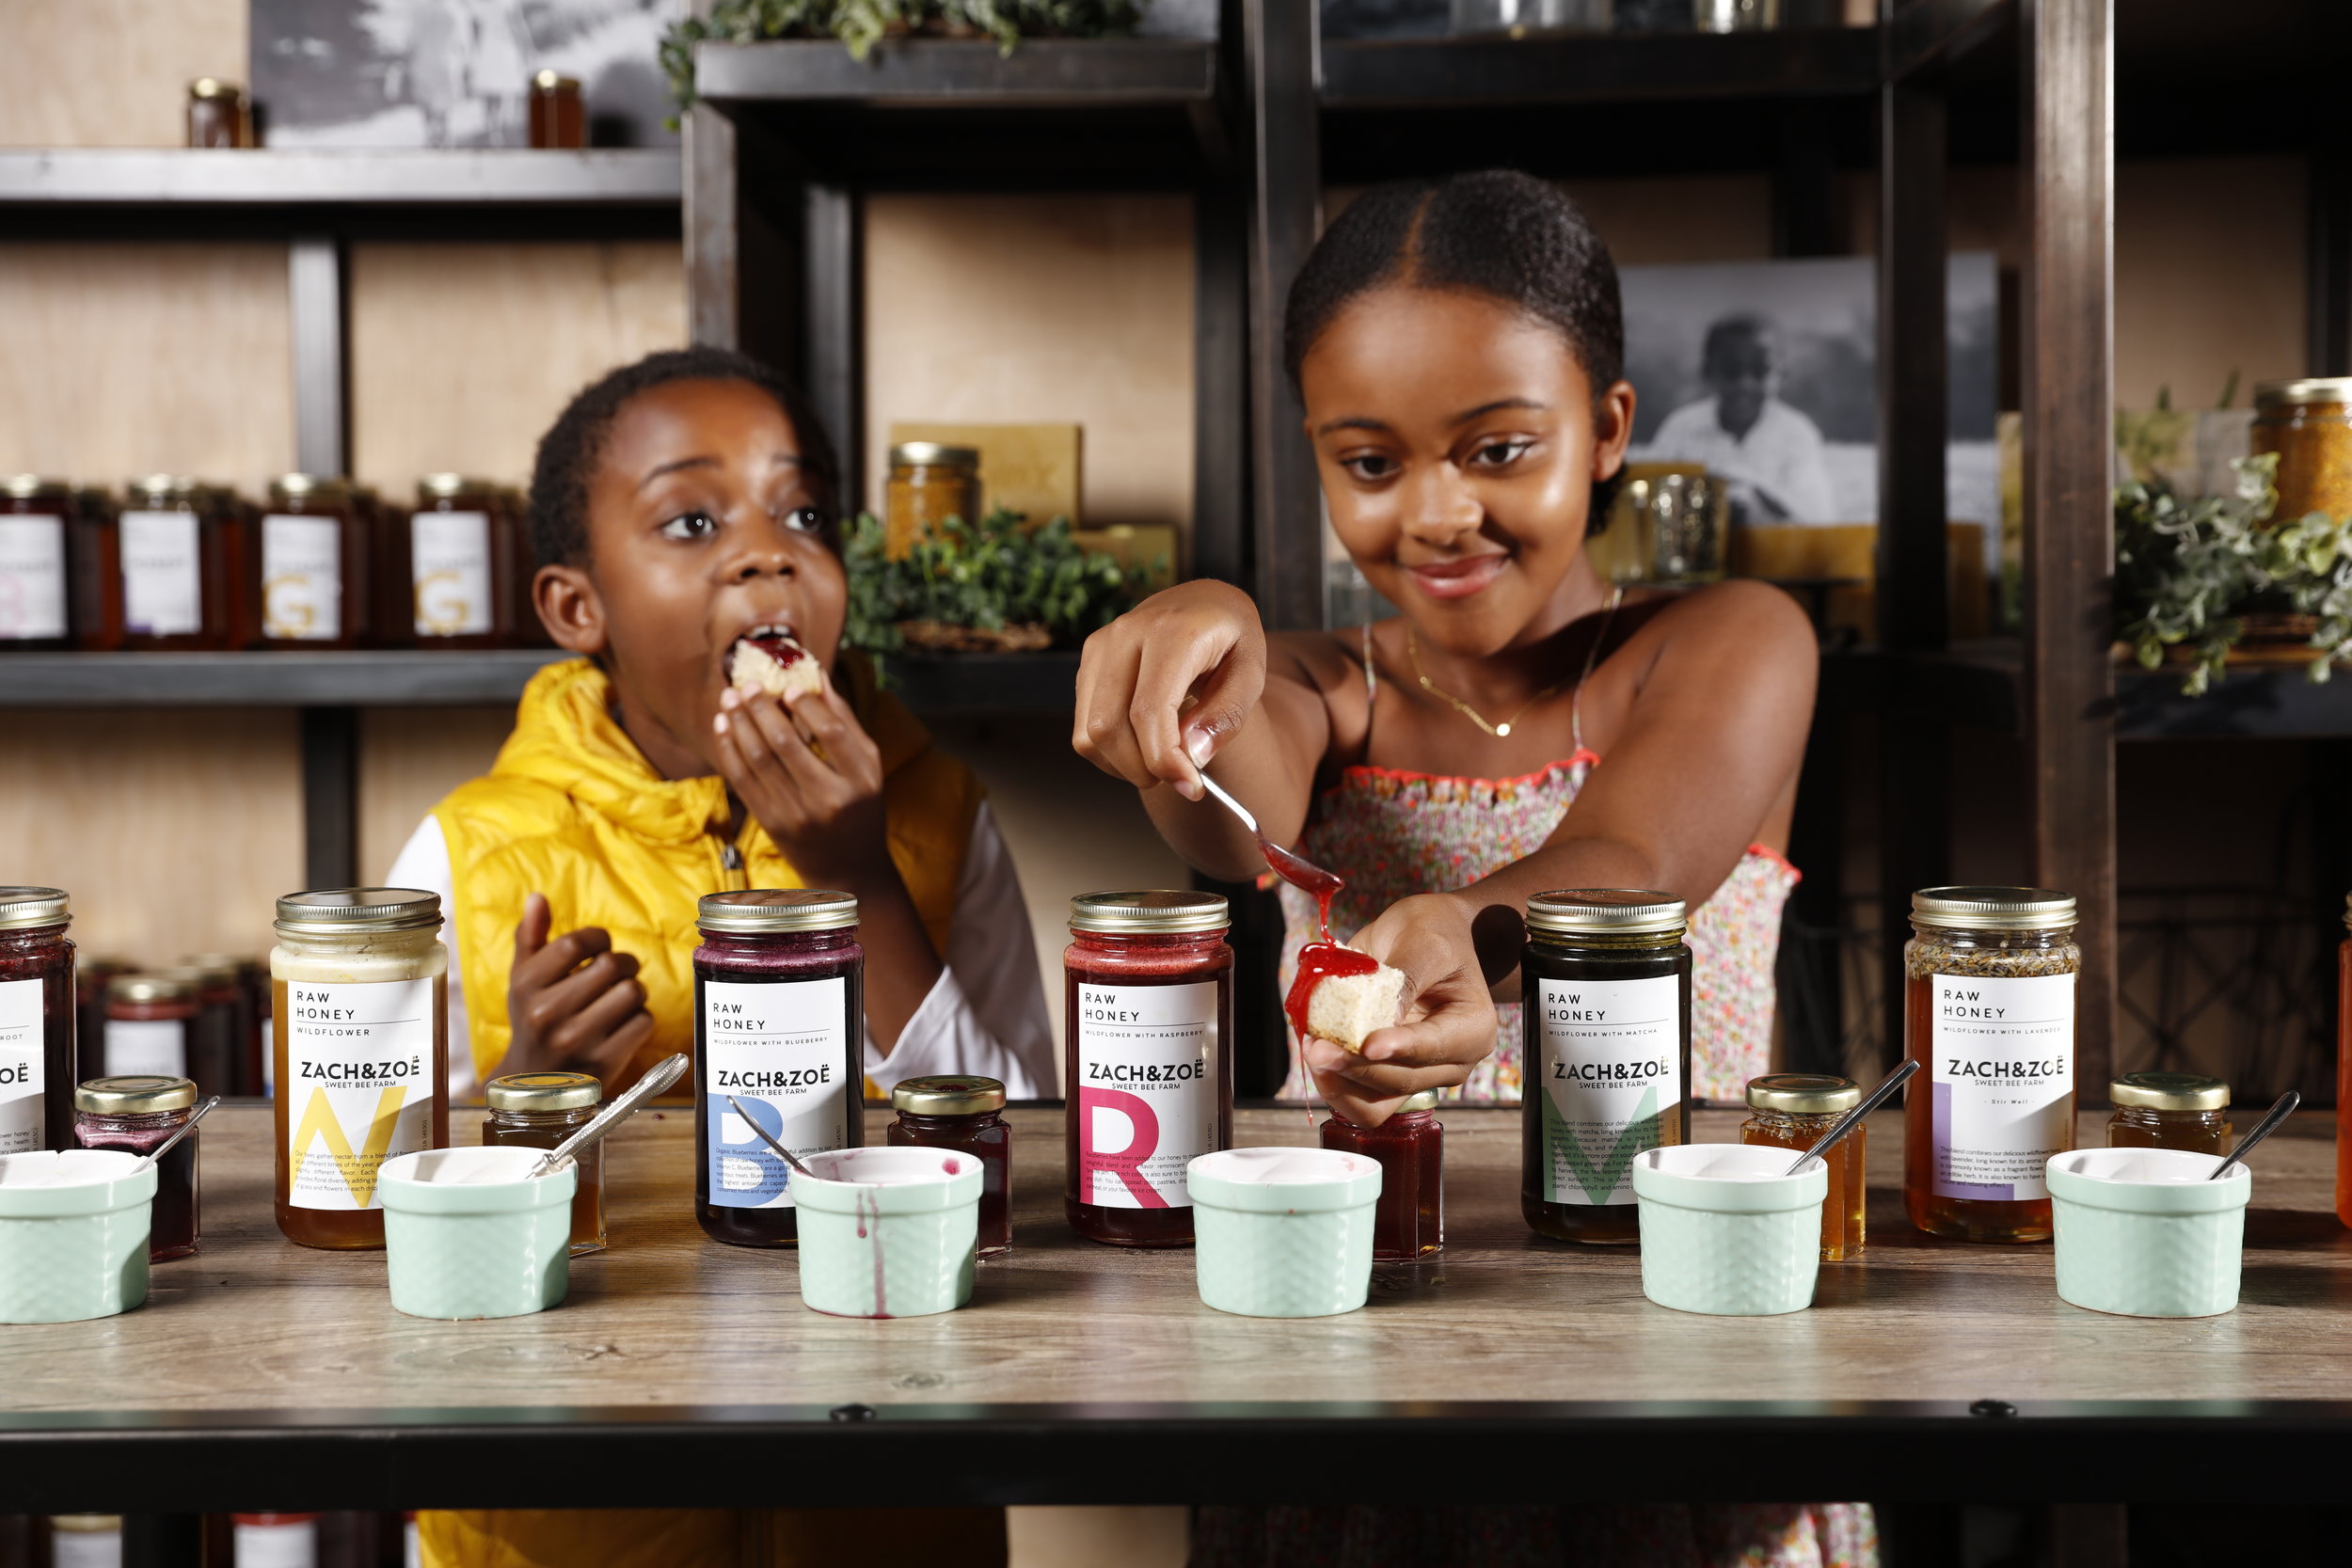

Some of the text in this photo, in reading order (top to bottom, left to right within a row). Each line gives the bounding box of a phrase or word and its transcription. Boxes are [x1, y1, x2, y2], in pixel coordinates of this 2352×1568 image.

[296, 990, 330, 1003] RAW
[1085, 992, 1115, 1005] RAW
[1549, 993, 1581, 1005] RAW
[1944, 990, 1979, 1001] RAW
[296, 1007, 355, 1020] HONEY
[713, 1003, 742, 1014] RAW
[1944, 1006, 2005, 1018] HONEY
[1085, 1009, 1139, 1022] HONEY
[1549, 1009, 1605, 1021] HONEY
[713, 1019, 765, 1030] HONEY
[1944, 1026, 1996, 1035] WILDFLOWER
[296, 1026, 370, 1037] WILDFLOWER
[1085, 1030, 1131, 1038] WILDFLOWER
[786, 1037, 828, 1045] BLUEBERRY
[301, 1055, 420, 1080] ZACH&ZOË
[1089, 1059, 1203, 1082] ZACH&ZOË
[1554, 1055, 1669, 1080] ZACH&ZOË
[1948, 1054, 2063, 1078] ZACH&ZOË
[718, 1064, 830, 1087] ZACH&ZOË
[1079, 1085, 1171, 1208] R
